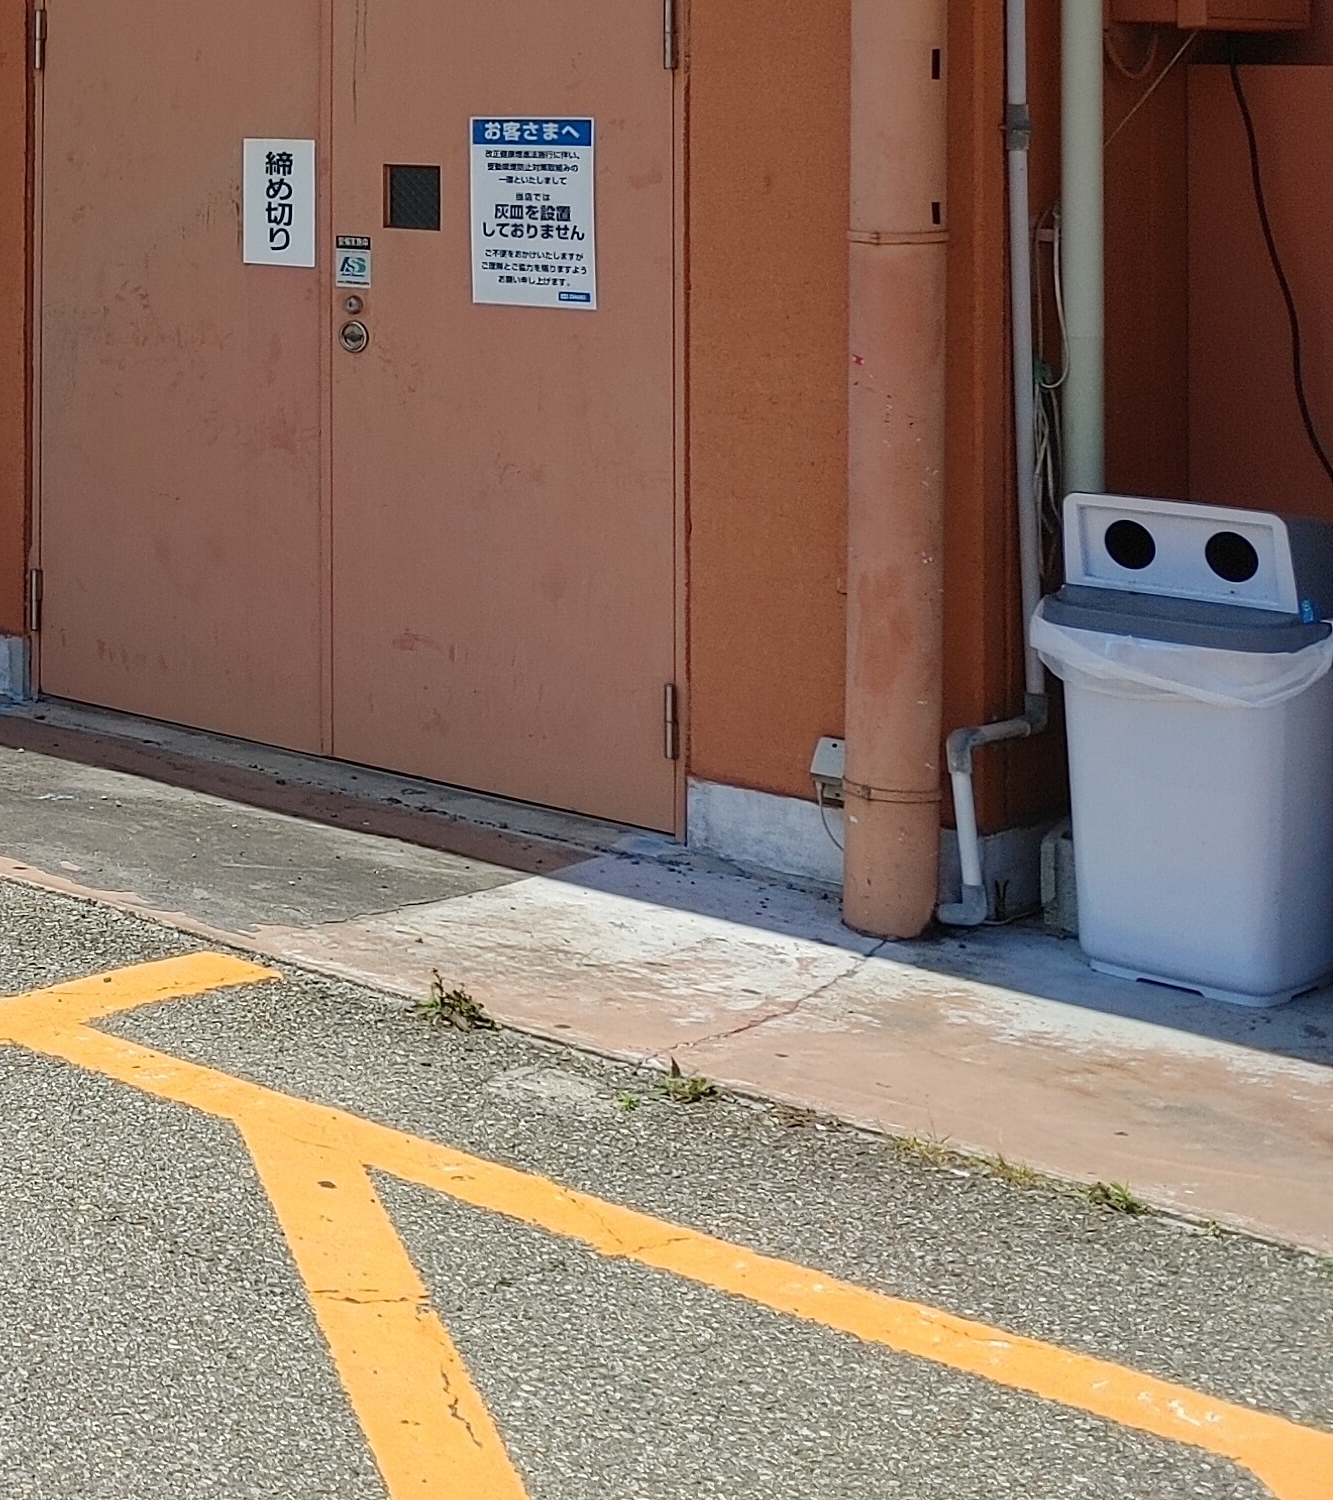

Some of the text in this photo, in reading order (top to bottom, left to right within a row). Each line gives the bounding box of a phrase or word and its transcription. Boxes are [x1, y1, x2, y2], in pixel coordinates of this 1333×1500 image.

[484, 121, 581, 141] お客さまへ
[265, 151, 294, 252] 締め切り
[494, 203, 572, 222] 灰皿を設置
[482, 221, 585, 241] しておりません
